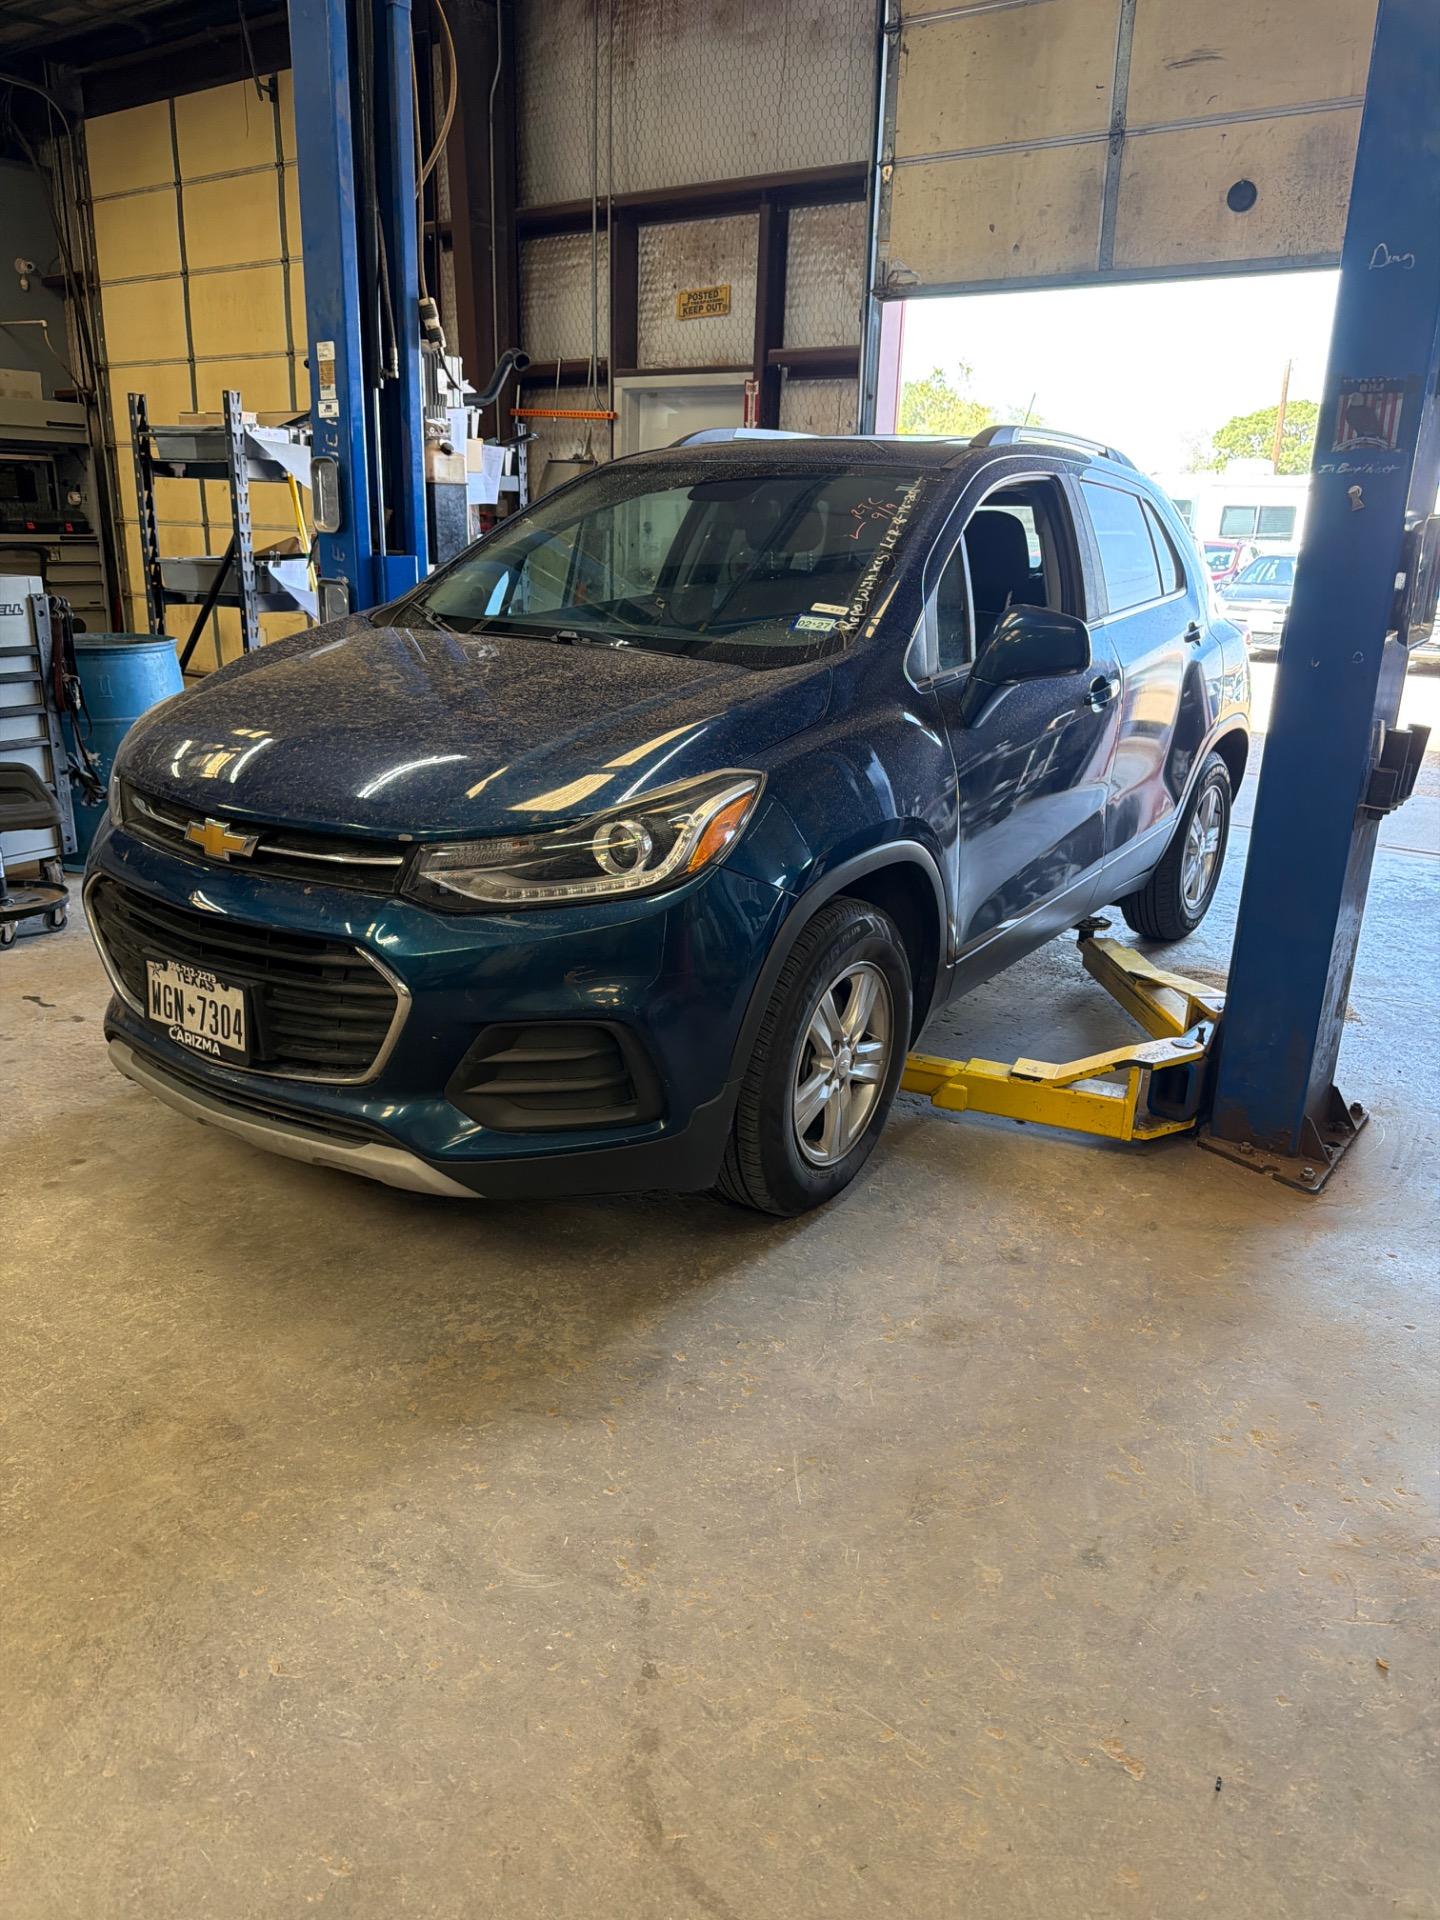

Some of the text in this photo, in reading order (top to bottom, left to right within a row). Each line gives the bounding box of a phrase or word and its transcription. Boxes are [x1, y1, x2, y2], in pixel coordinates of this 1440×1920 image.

[687, 289, 719, 301] POSTED
[682, 303, 723, 317] KEEP OUT
[176, 969, 215, 993] TEXAS
[152, 980, 242, 1045] WGN 7304
[168, 1026, 221, 1056] CARIZMA
